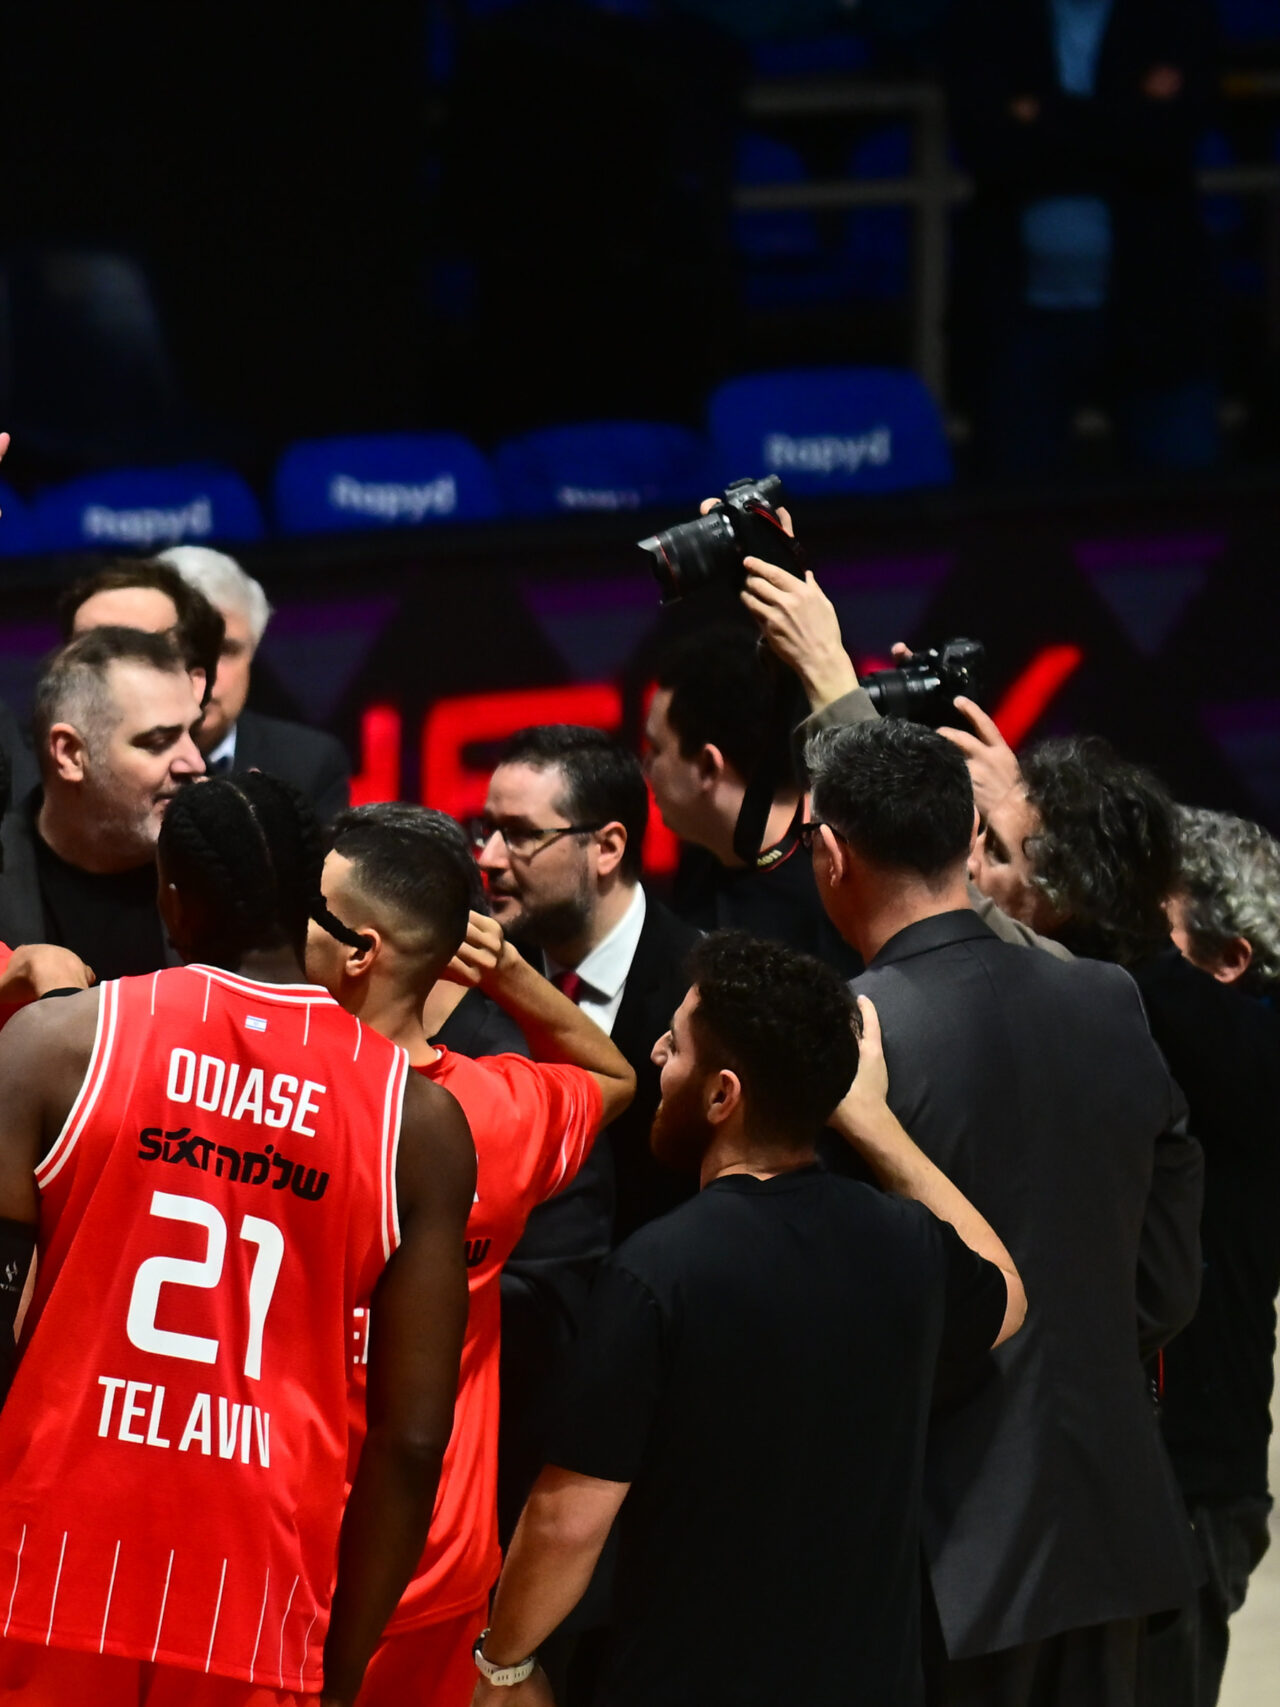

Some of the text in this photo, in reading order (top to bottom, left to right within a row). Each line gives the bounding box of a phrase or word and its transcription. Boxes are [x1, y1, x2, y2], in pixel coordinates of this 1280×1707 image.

[166, 1047, 327, 1138] ODIASE
[126, 1190, 285, 1381] 21
[97, 1375, 270, 1469] TEL AVIV
